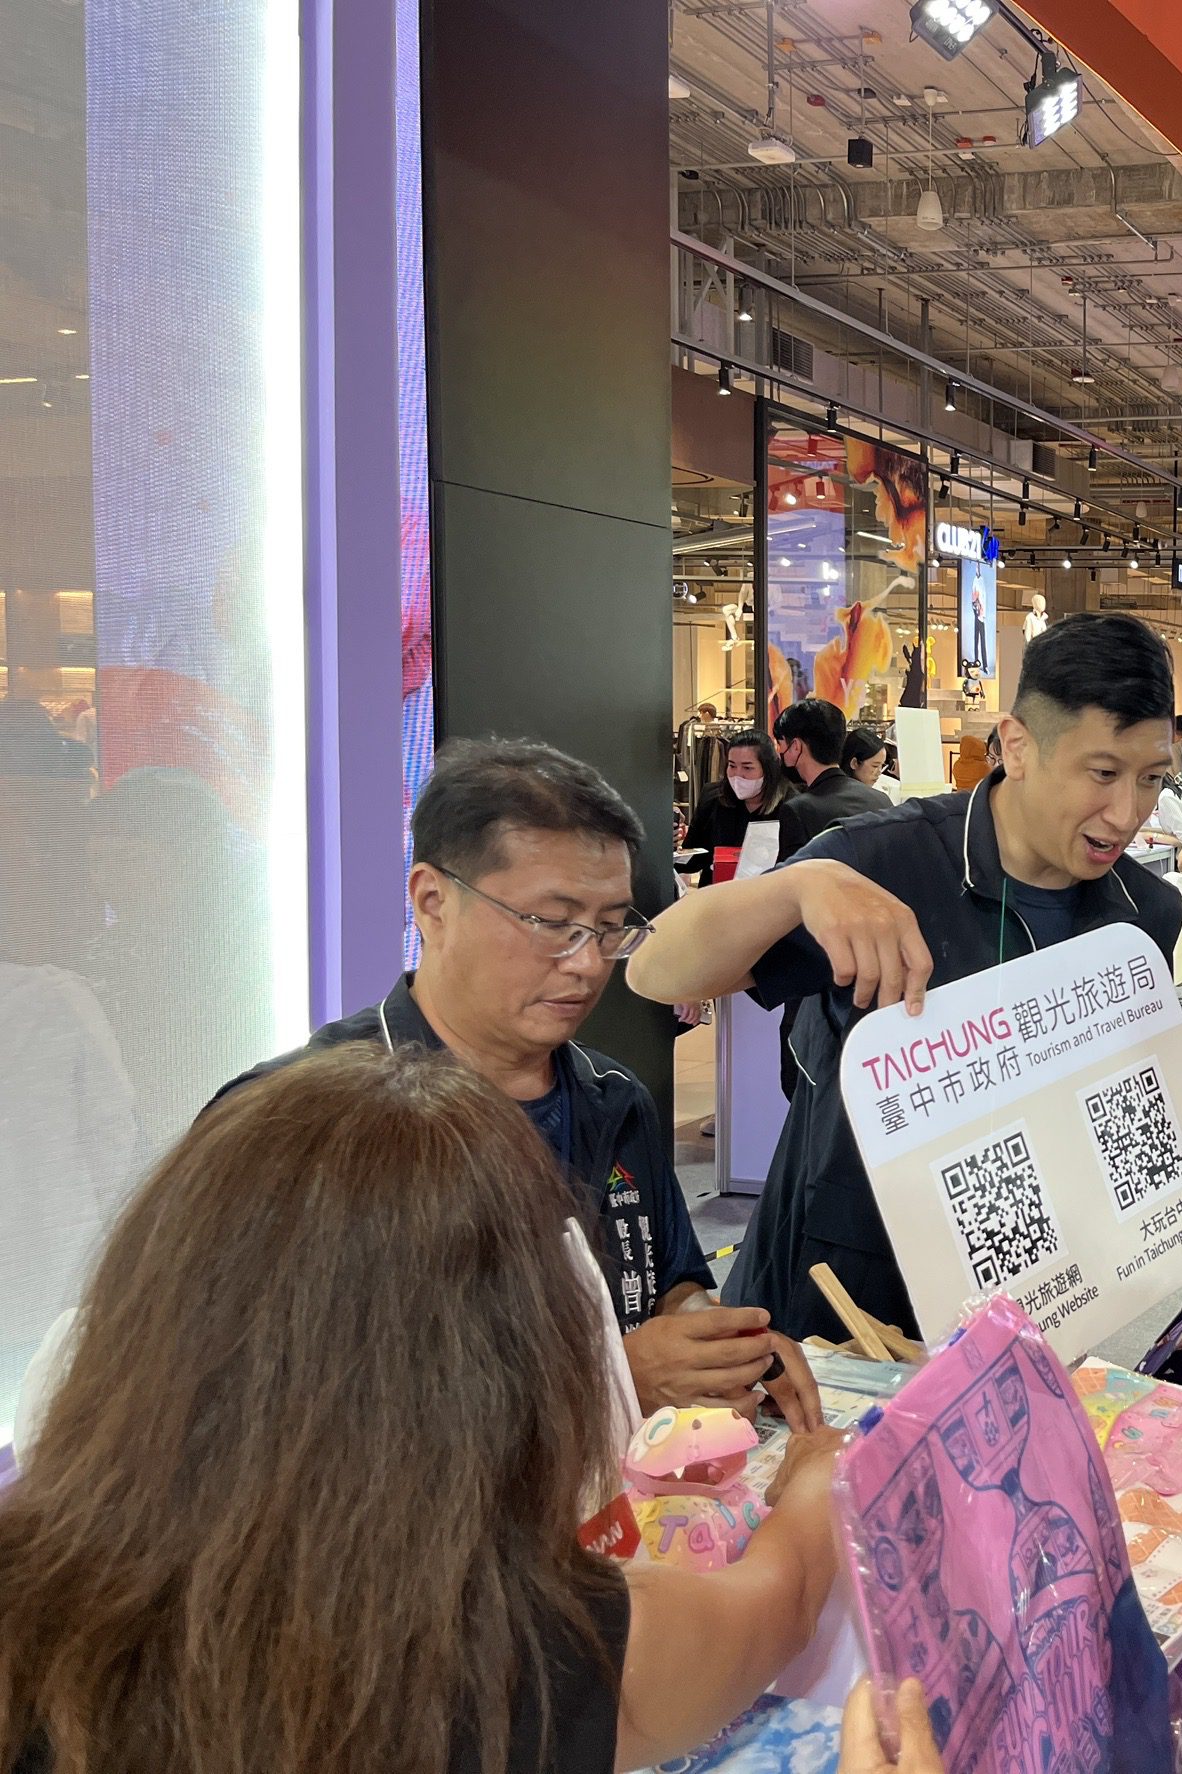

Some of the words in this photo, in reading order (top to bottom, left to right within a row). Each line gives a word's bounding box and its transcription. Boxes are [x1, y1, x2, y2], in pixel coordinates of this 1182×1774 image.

[1012, 955, 1155, 1043] 觀光旅遊局
[1026, 1039, 1071, 1067] Tourism
[1073, 1026, 1094, 1047] and
[1093, 1011, 1126, 1038] Travel
[1127, 999, 1164, 1024] Bureau
[862, 1007, 1012, 1091] TAICHUNG
[875, 1045, 1022, 1136] 臺中市政府
[1057, 1286, 1100, 1319] Website
[1116, 1262, 1136, 1281] Fun
[1133, 1255, 1146, 1270] in
